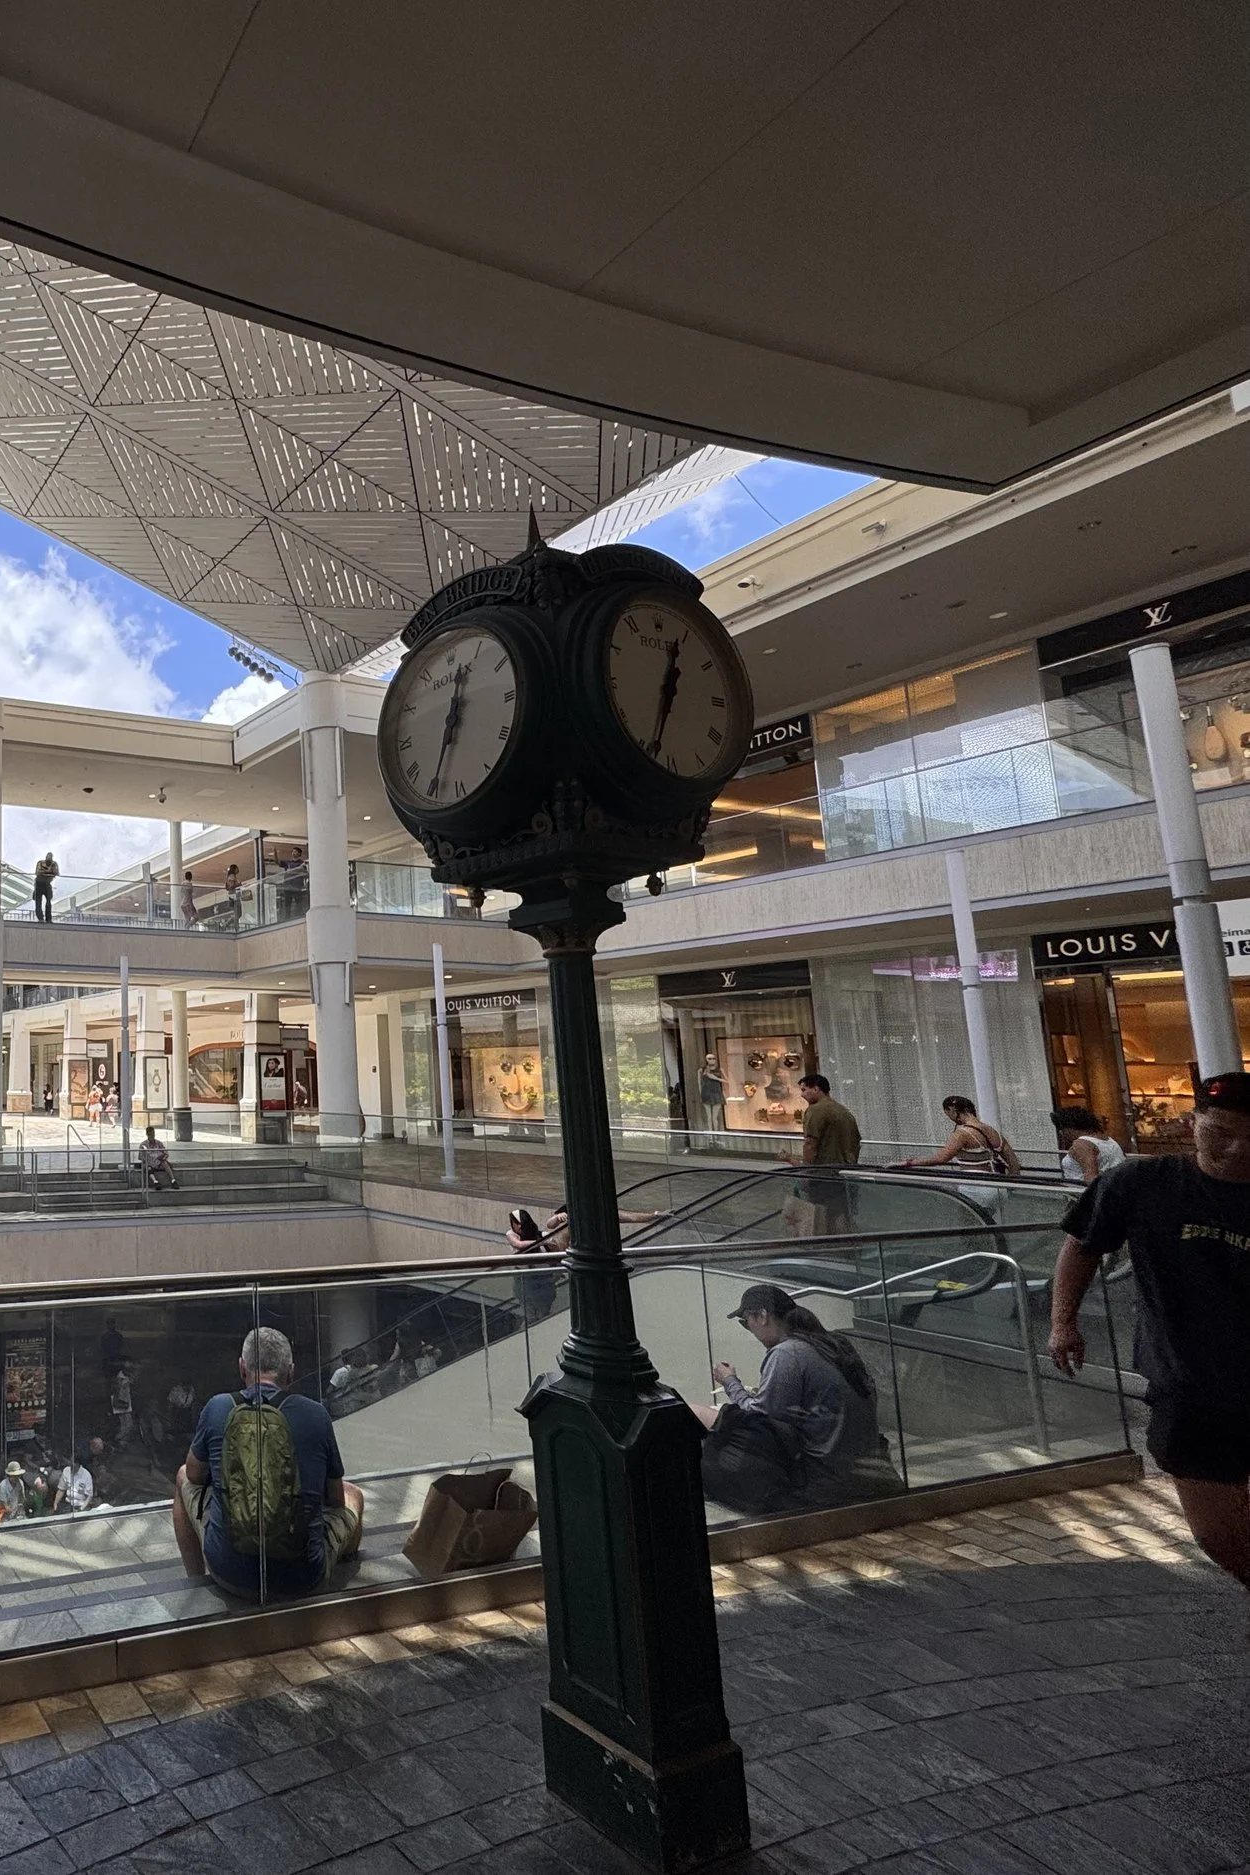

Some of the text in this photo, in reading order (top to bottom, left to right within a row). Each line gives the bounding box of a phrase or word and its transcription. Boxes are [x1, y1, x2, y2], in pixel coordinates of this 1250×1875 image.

[405, 568, 515, 641] BEN BRIDGE
[639, 636, 679, 652] ROLE
[432, 661, 472, 691] ROLX
[750, 721, 803, 749] ITTON
[1046, 929, 1171, 959] LOUIS V
[445, 994, 521, 1012] OUIS VUITTON
